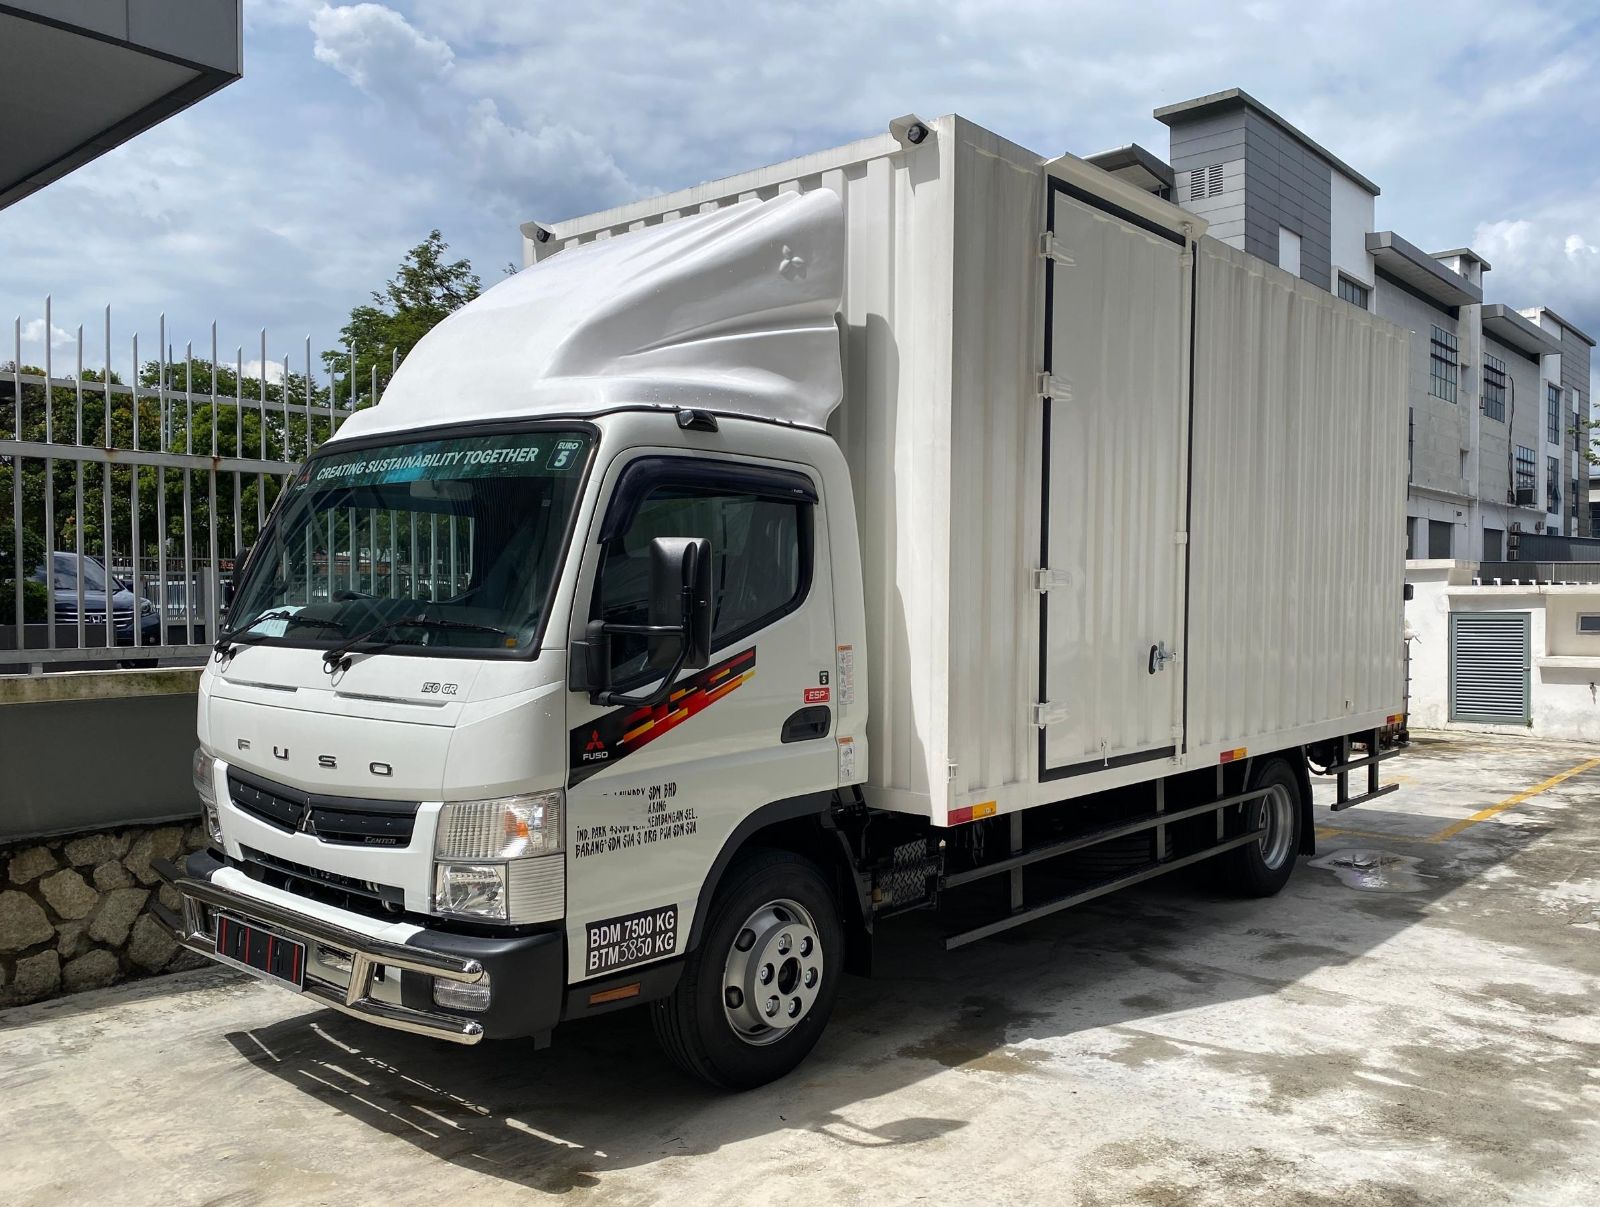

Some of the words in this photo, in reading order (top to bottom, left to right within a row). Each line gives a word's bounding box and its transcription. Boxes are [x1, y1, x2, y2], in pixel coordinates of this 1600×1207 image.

[557, 442, 579, 450] EURO
[316, 465, 365, 481] CREATING
[367, 450, 464, 474] SUSTAINABILITY
[463, 447, 539, 464] TOGETHER
[554, 451, 570, 467] 5
[421, 682, 440, 694] 150
[441, 683, 458, 695] GR
[808, 690, 825, 700] ESP
[237, 738, 393, 777] FUSO
[583, 751, 608, 761] FUSO
[664, 782, 677, 798] BHD
[590, 923, 620, 949] BDM
[624, 916, 653, 940] 7500
[656, 910, 675, 932] KG
[589, 945, 619, 971] BTM
[619, 937, 652, 962] 3850
[655, 931, 674, 953] KG
